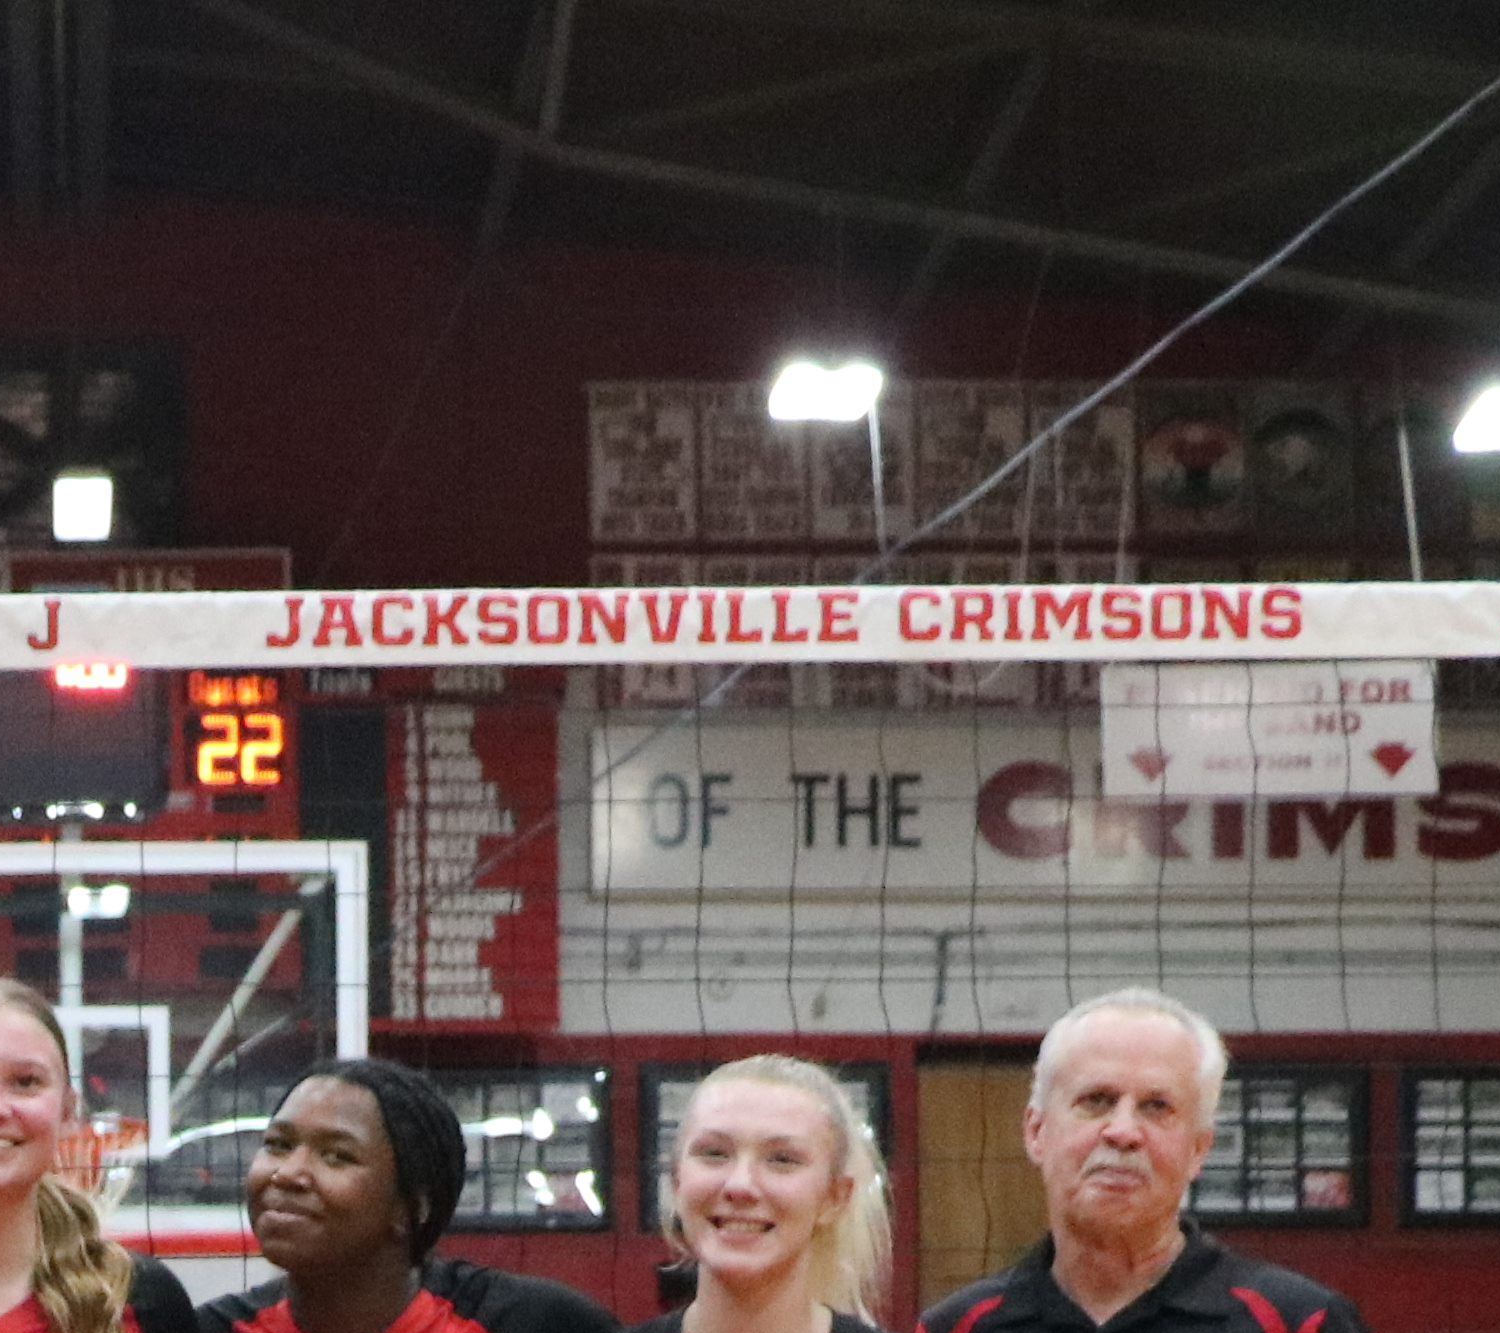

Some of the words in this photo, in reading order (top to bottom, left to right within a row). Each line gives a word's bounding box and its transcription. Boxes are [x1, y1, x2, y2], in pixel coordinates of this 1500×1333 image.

[26, 599, 62, 651] J
[265, 589, 861, 649] JACKSONVILLE
[897, 586, 1304, 643] CRIMSONS
[1340, 678, 1412, 704] FOR
[196, 713, 285, 786] 22
[646, 772, 732, 850] OF
[792, 773, 924, 848] THE
